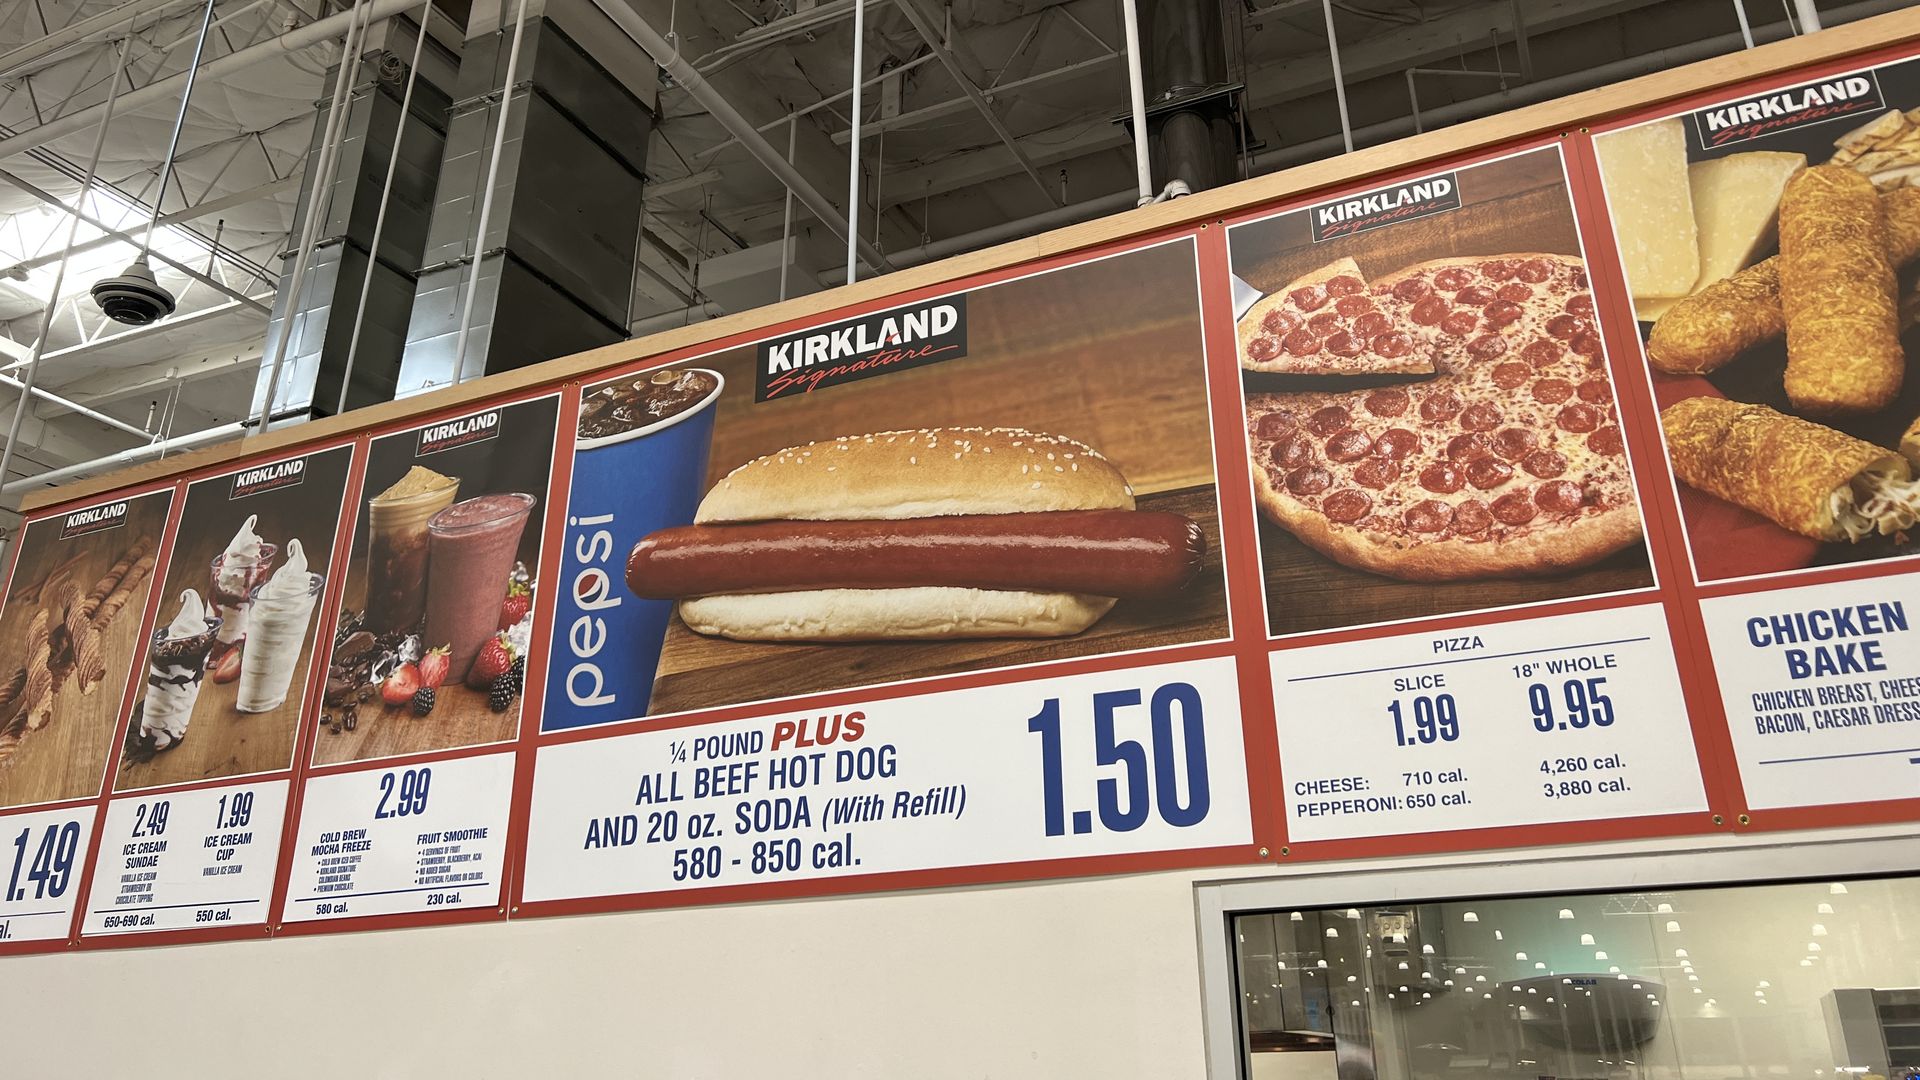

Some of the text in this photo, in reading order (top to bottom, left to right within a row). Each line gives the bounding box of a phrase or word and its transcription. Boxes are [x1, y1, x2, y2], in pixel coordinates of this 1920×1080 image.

[1705, 76, 1870, 131] KIRKLAND
[1711, 101, 1875, 146] Signature
[1319, 179, 1451, 226] KIRKLAND
[1321, 200, 1454, 239] Signature
[767, 304, 958, 375] KIRKLAND
[766, 343, 958, 399] Signature
[422, 412, 498, 443] KIRKLAND
[236, 460, 304, 487] KIRKLAND
[66, 503, 127, 528] KIRKLAND
[566, 513, 621, 707] pepsi
[1746, 601, 1909, 648] CHICKEN
[1432, 635, 1485, 654] PIZZA
[1512, 653, 1617, 680] 18" WHOLE
[1784, 640, 1888, 680] BAKE
[1393, 674, 1446, 693] SLICE
[1752, 688, 1815, 712] CHICKEN
[1816, 682, 1878, 704] BREAST,
[1528, 676, 1615, 733] 9.95
[1387, 693, 1460, 747] 1.99
[1755, 712, 1811, 735] BACON,
[1813, 706, 1872, 730] CAESAR
[693, 730, 764, 761] POUND
[770, 711, 866, 751] PLUS
[1027, 682, 1210, 837] 1.50
[1539, 754, 1626, 776] 4,260 cal.
[635, 744, 897, 806] ALL BEEF HOT DOG
[1294, 767, 1468, 796] CHEESE: 710 cal.
[1543, 776, 1631, 799] 3,880 cal.
[374, 767, 432, 819] 2.99
[1296, 790, 1472, 818] PEPPERONI: 650 cal.
[132, 801, 170, 837] 2.49
[216, 792, 254, 829] 1.99
[584, 784, 967, 849] AND 20 oz. SODA (With Refill)
[122, 841, 167, 856] ICE CREAM
[204, 832, 253, 848] ICE CREAM
[311, 840, 372, 856] MOCHA FREEZE
[320, 829, 367, 844] COLD BREW
[417, 827, 488, 845] FRUIT SMOOTHIE
[6, 821, 80, 901] 1.49
[125, 855, 159, 869] SUNDAE
[216, 849, 234, 861] CUP
[672, 845, 721, 881] 580
[751, 838, 800, 875] 850
[812, 833, 861, 867] cal.
[316, 902, 348, 915] 580 cal.
[427, 892, 462, 905] 230 cal.
[104, 913, 155, 928] 650-690 cal.
[196, 908, 232, 922] 550 cal.
